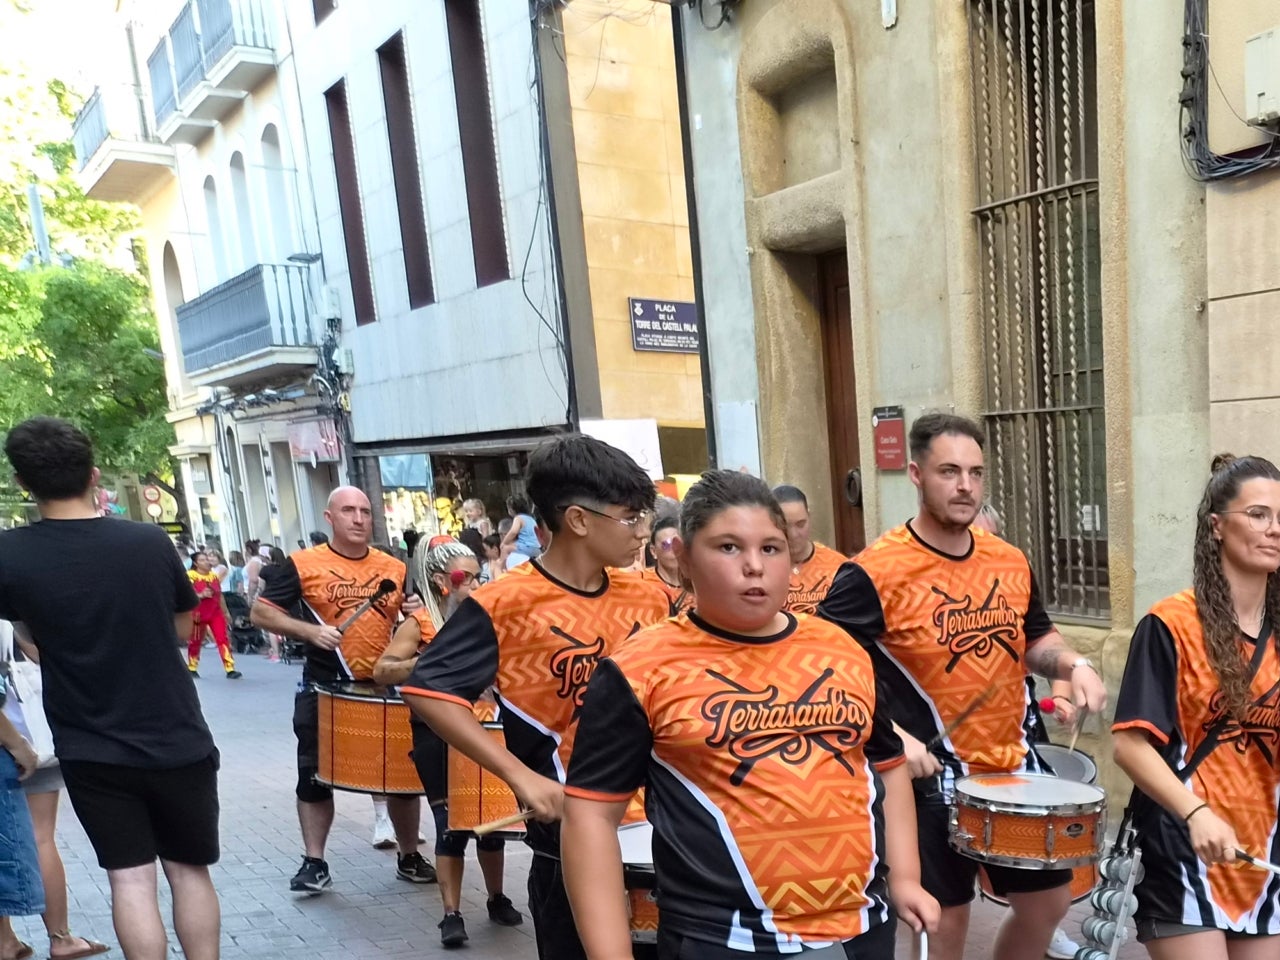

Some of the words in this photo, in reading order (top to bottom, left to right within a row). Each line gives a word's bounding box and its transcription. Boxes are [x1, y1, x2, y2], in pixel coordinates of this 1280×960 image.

[635, 320, 651, 329] TORRE
[651, 321, 662, 331] DEL
[662, 321, 682, 332] CASTELL
[327, 577, 382, 603] Terrasam
[933, 594, 1017, 645] Terrasamba
[702, 684, 867, 748] Terrasamba
